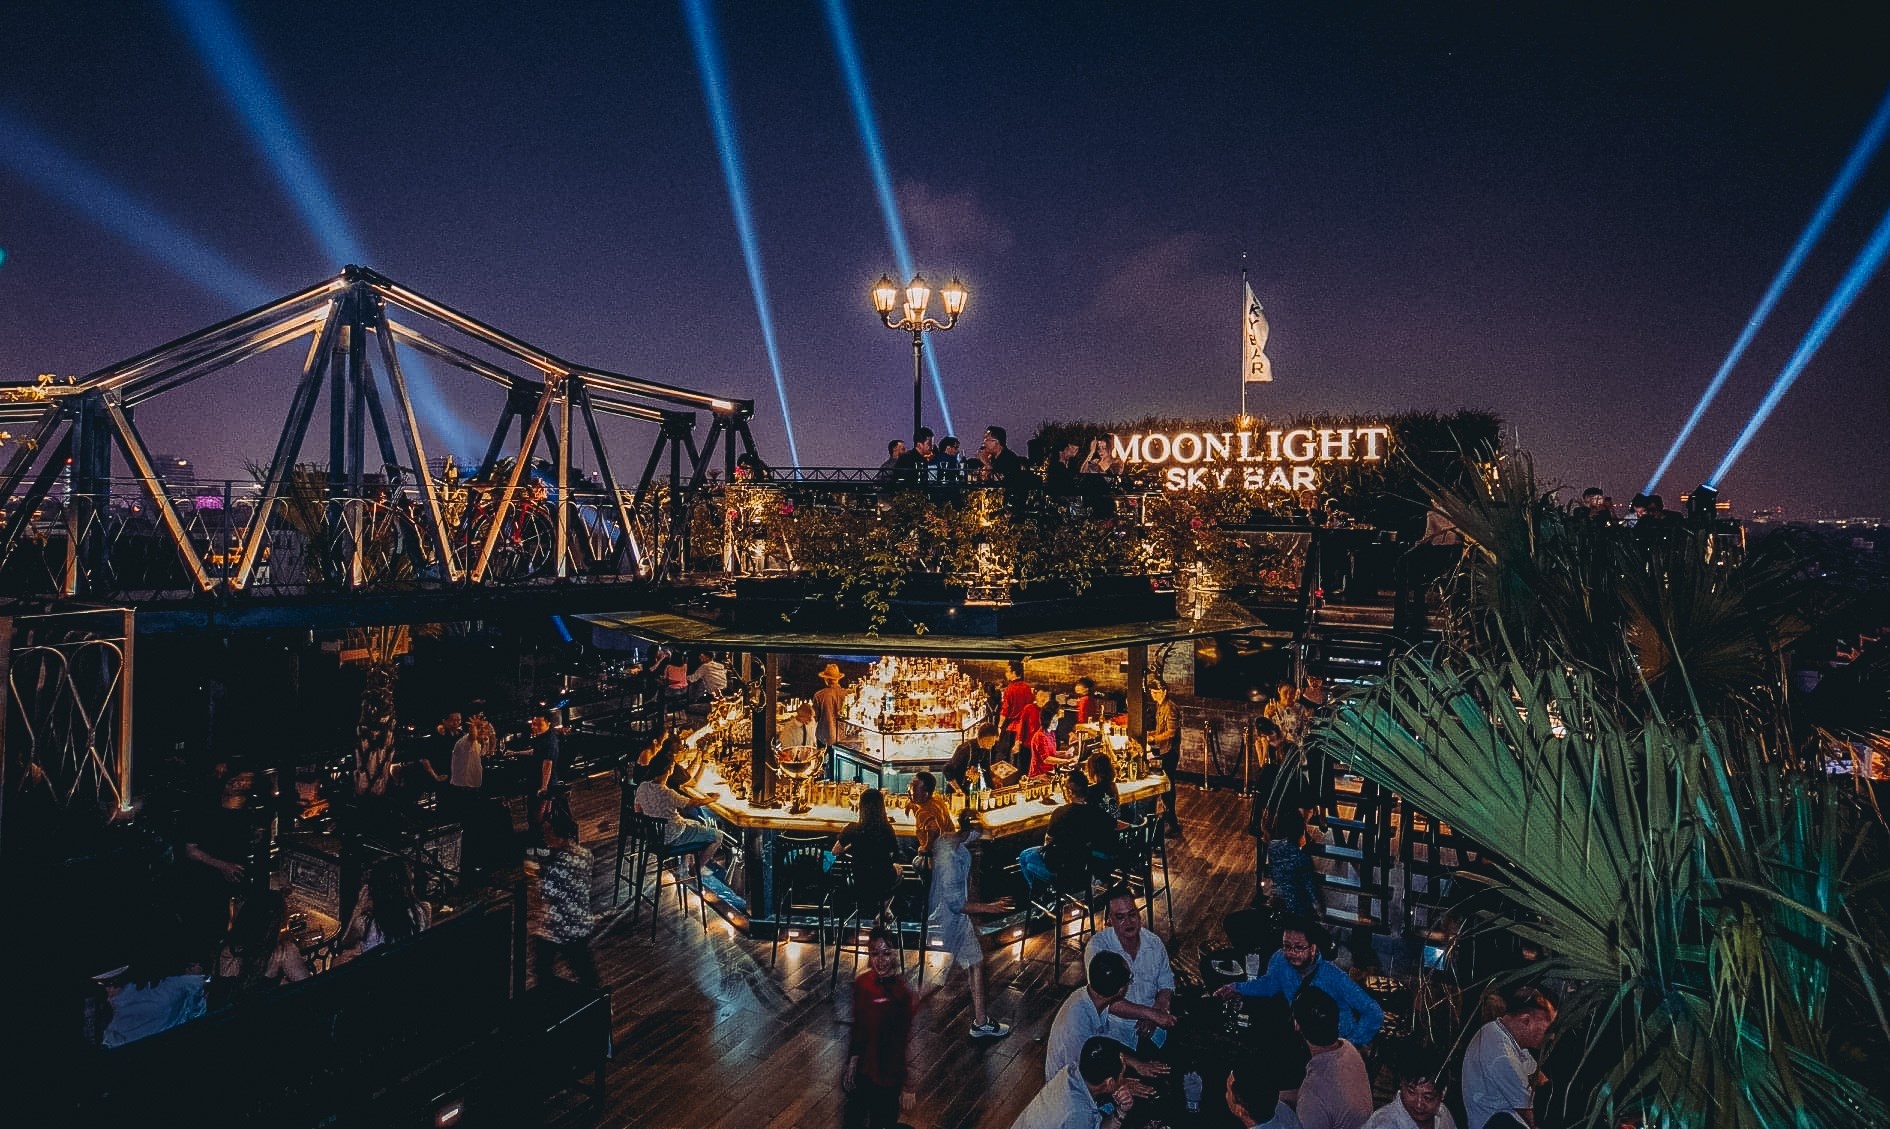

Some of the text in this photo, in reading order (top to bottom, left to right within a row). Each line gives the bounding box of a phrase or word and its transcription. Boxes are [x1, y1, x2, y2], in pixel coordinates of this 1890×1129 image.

[1112, 427, 1388, 464] MOONLIGHT
[1166, 467, 1317, 491] SKY BAR
